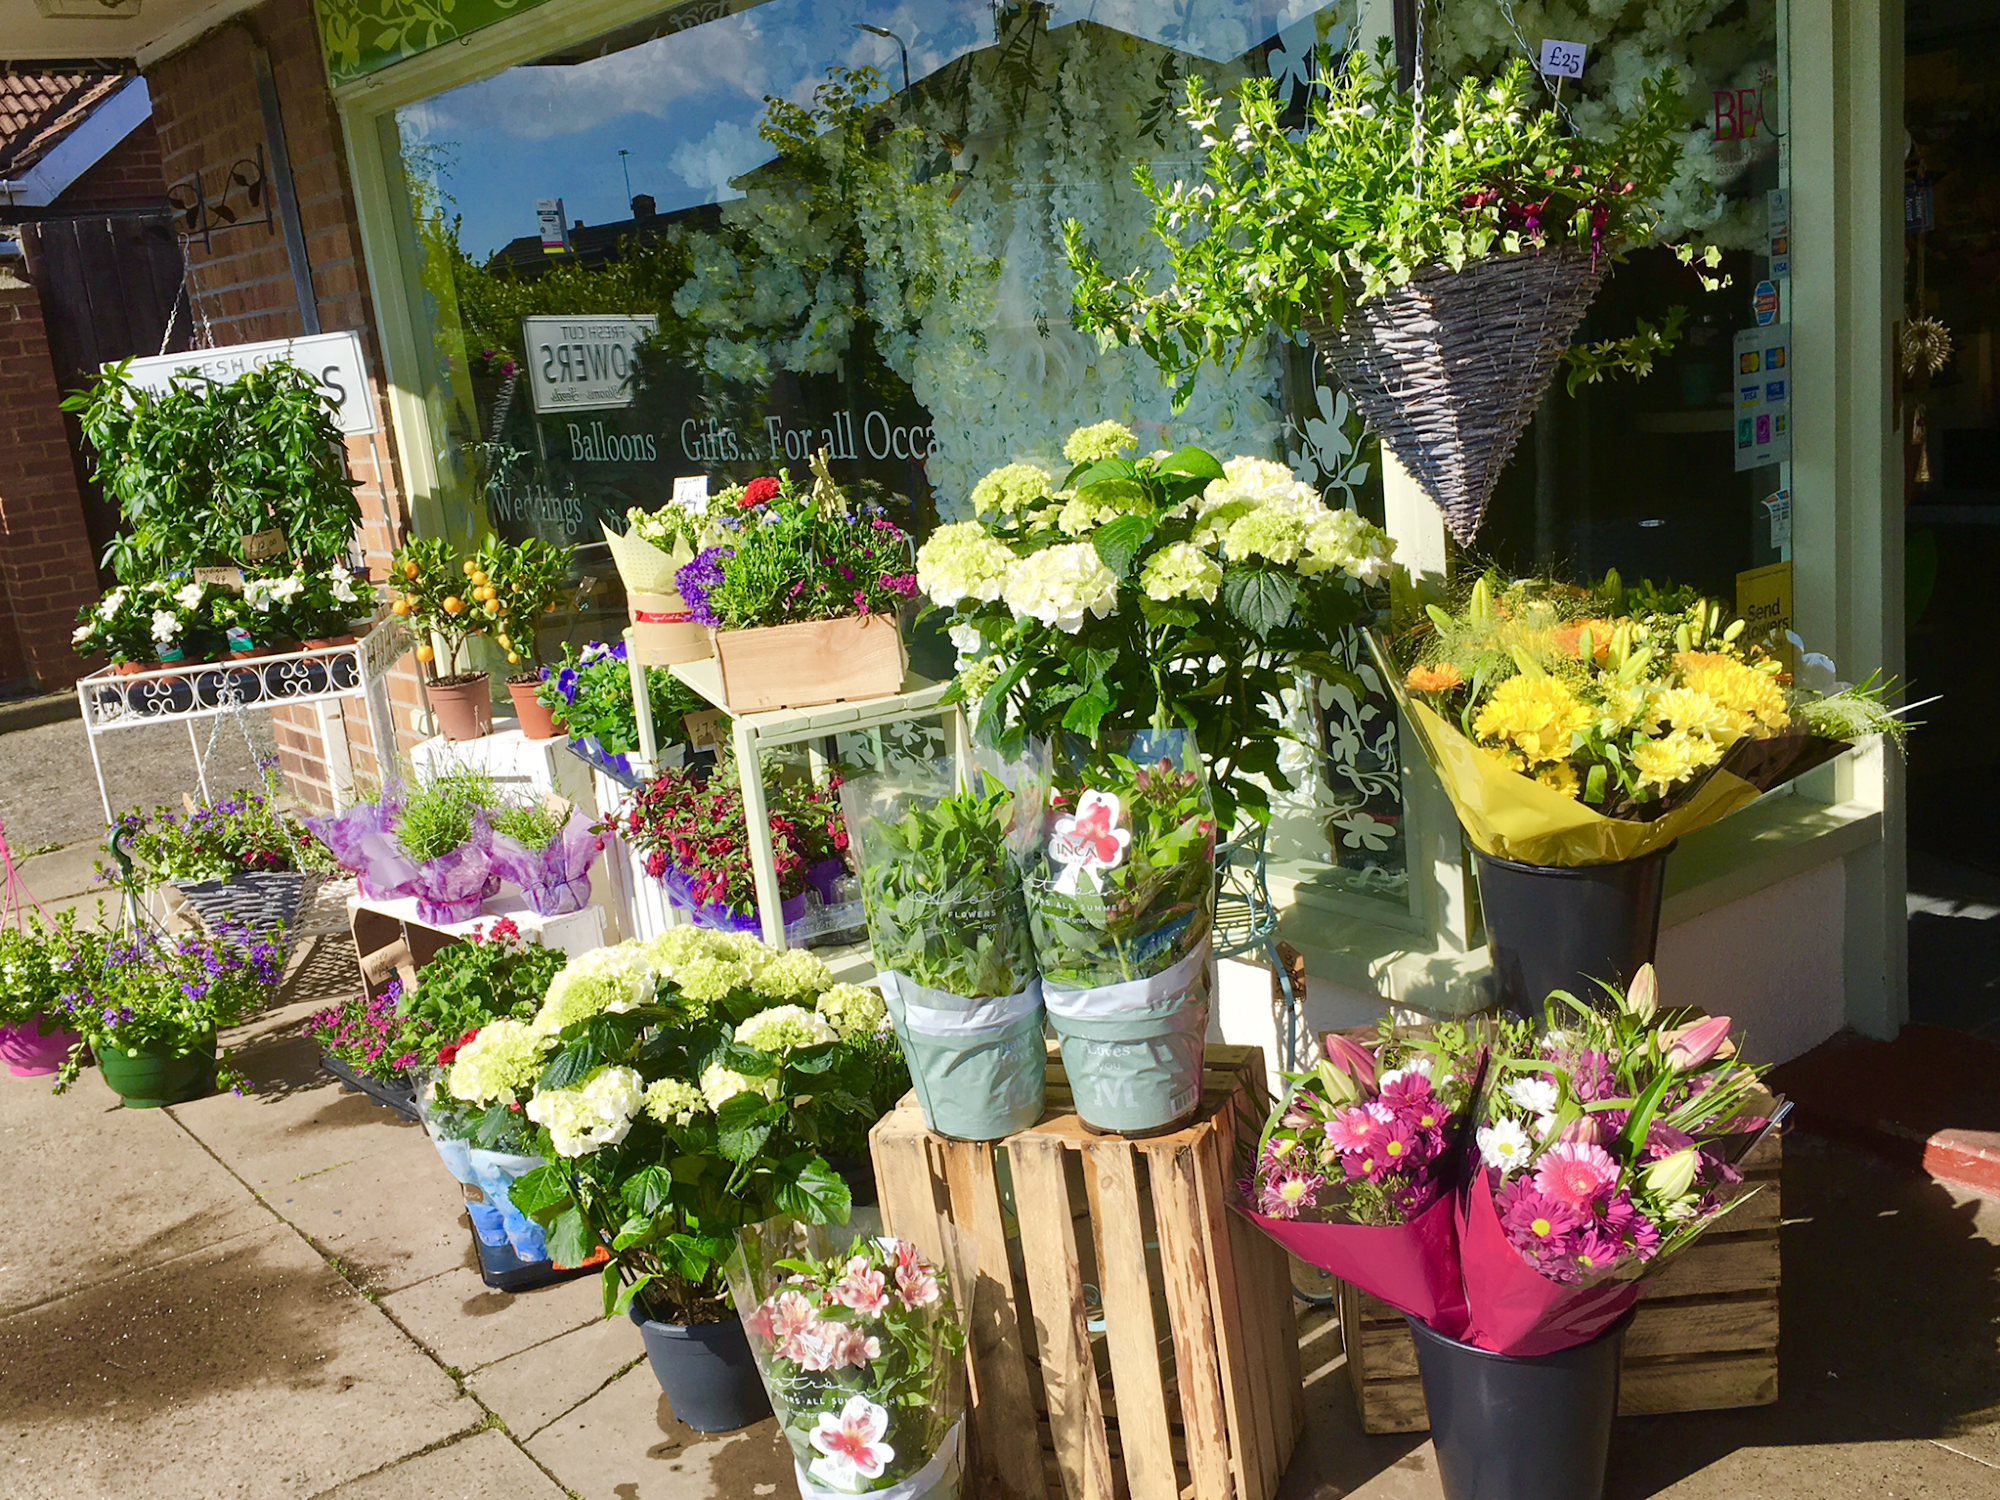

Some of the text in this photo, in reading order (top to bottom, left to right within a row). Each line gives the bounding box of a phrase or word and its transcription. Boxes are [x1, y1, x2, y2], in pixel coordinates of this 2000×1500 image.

[1548, 46, 1580, 74] £25
[567, 422, 657, 463] Balloons
[766, 415, 813, 461] For
[822, 411, 858, 461] all
[864, 410, 940, 462] Occa
[491, 483, 583, 537] Weddings
[1747, 597, 1781, 622] Send
[1056, 842, 1098, 859] INCA
[947, 908, 997, 919] FLOWERS
[1056, 902, 1075, 911] ALL
[1084, 1042, 1131, 1058] Loves
[1098, 1061, 1121, 1073] you
[1089, 1075, 1139, 1109] M
[805, 1398, 826, 1406] ALL
